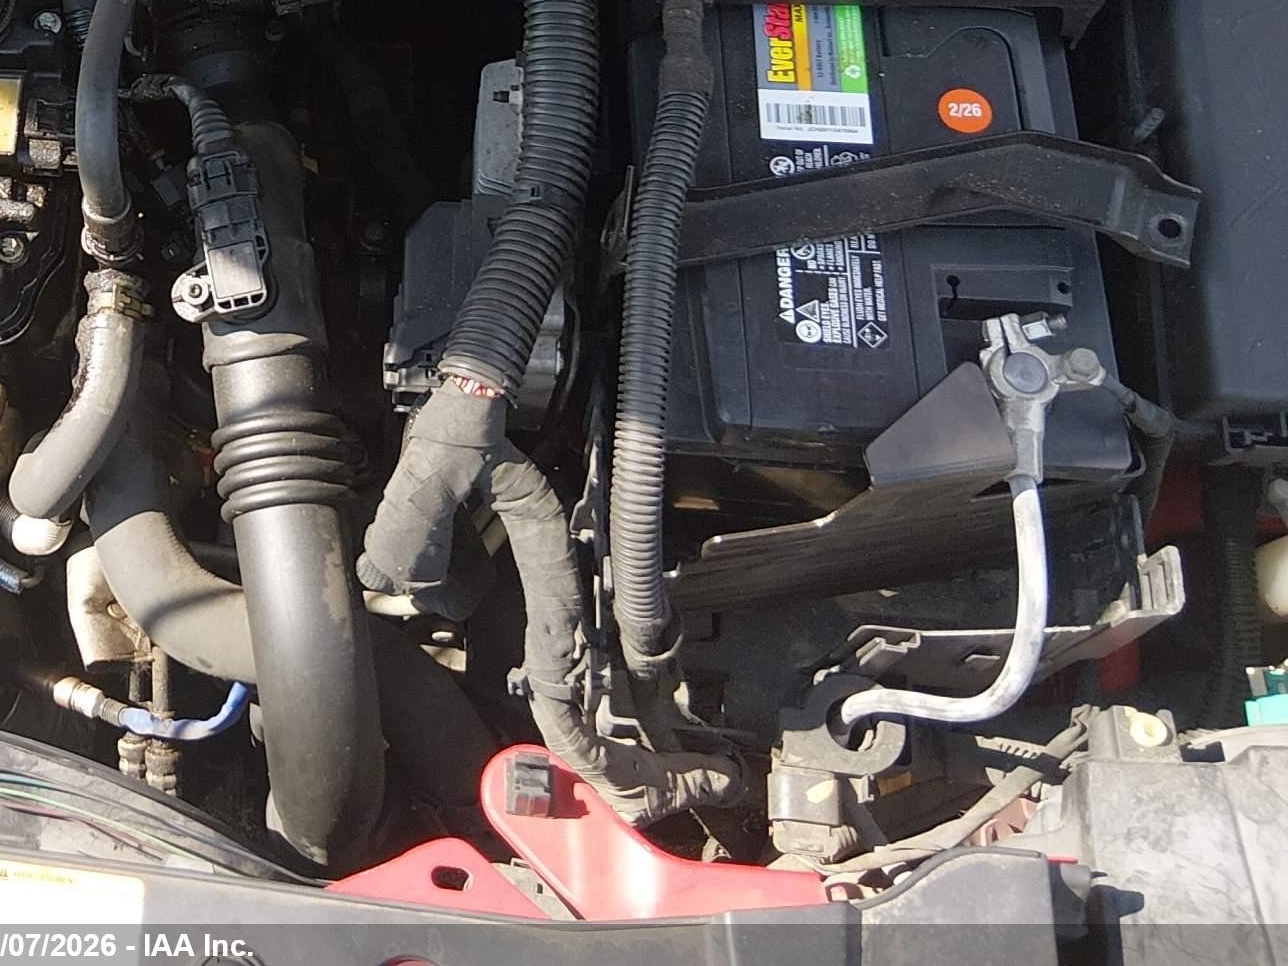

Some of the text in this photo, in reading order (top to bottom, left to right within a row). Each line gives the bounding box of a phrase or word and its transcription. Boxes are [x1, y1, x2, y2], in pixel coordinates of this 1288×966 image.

[762, 3, 796, 82] EverSta
[948, 102, 982, 118] 2/26
[776, 248, 794, 309] DANGER
